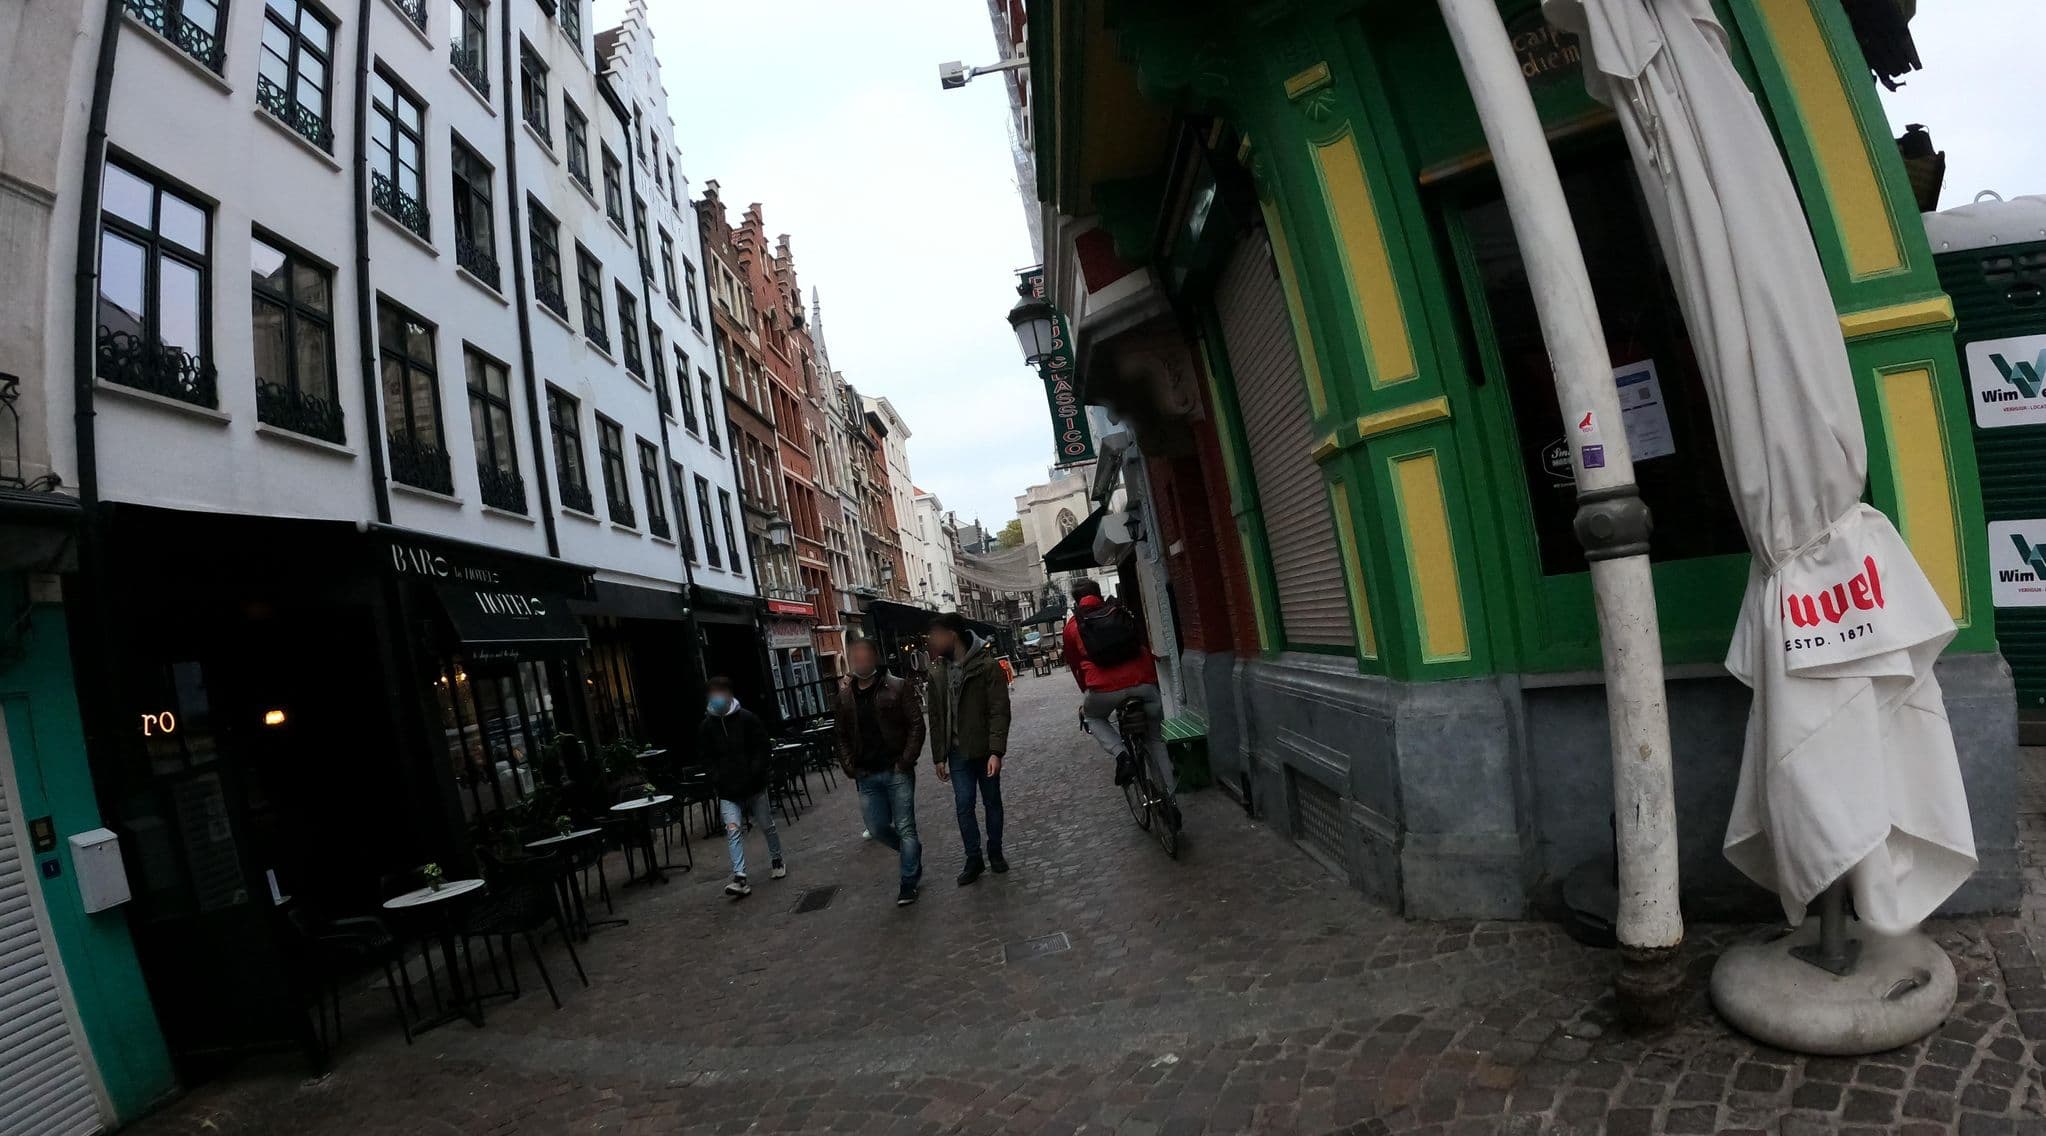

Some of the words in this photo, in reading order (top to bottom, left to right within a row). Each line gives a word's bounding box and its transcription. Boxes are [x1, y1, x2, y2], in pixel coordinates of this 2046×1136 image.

[1982, 389, 2018, 403] Wim
[1999, 569, 2035, 583] Wim
[1781, 555, 1884, 628] uvel
[1785, 636, 1831, 651] ESTD.
[1840, 622, 1874, 642] 1871
